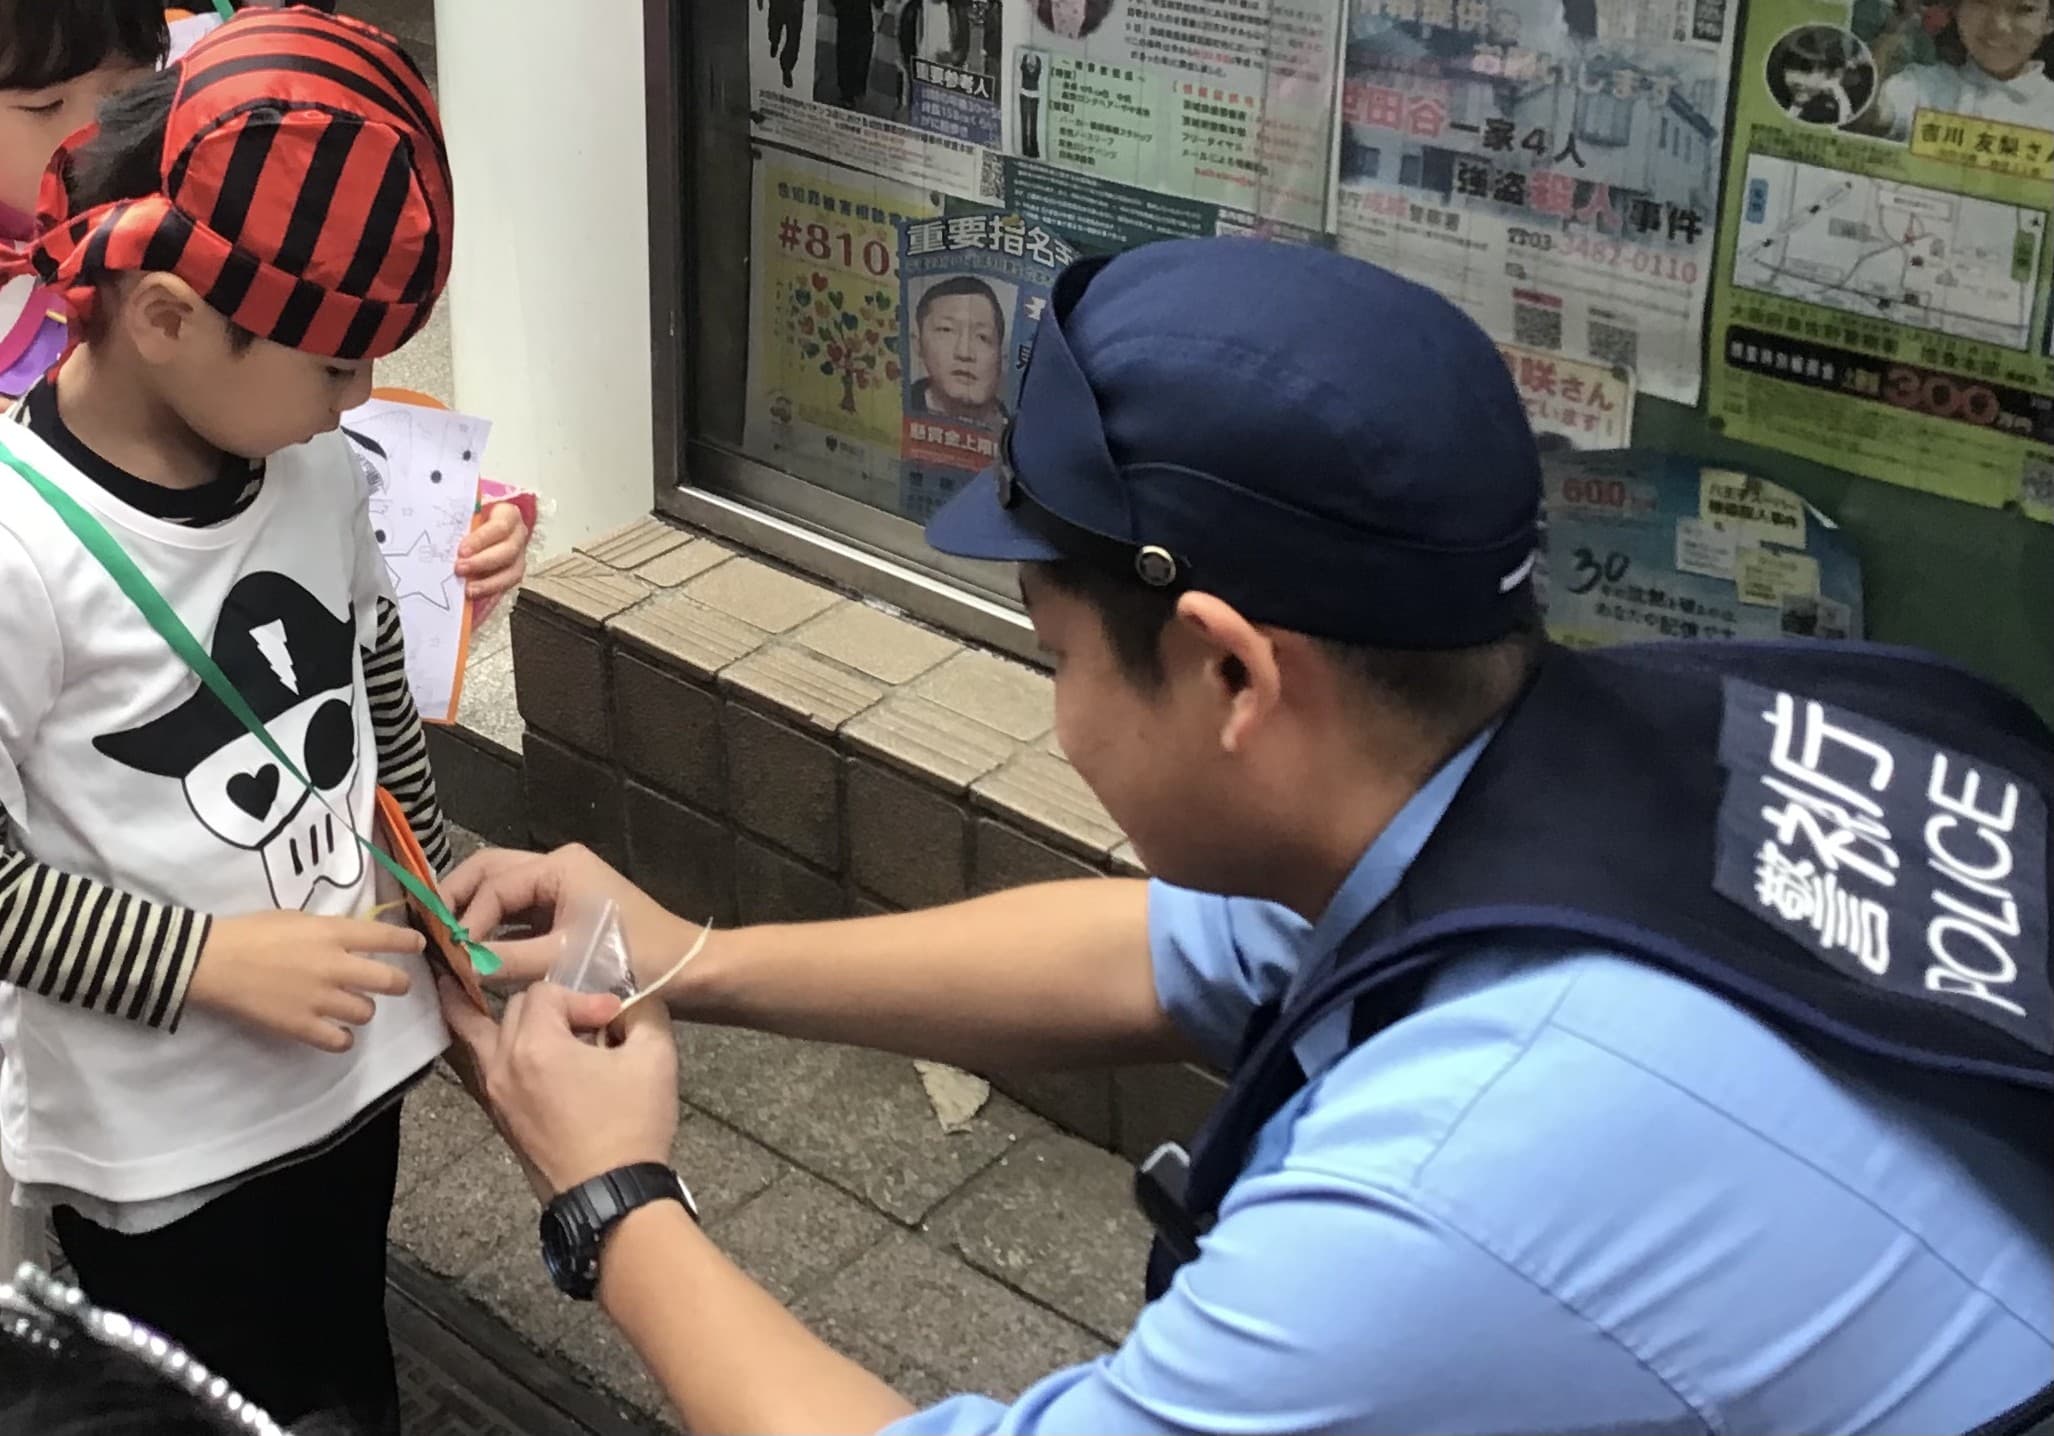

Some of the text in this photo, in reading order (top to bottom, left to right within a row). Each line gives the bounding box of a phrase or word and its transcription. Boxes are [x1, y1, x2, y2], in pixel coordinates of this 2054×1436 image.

[1458, 160, 1702, 245] 強盗殺人事件
[778, 215, 899, 276] #810
[910, 422, 998, 457] 懸賞金上限
[1567, 546, 1630, 594] 30
[1754, 691, 1900, 976] 警視庁
[1923, 752, 2026, 1017] POLICE
